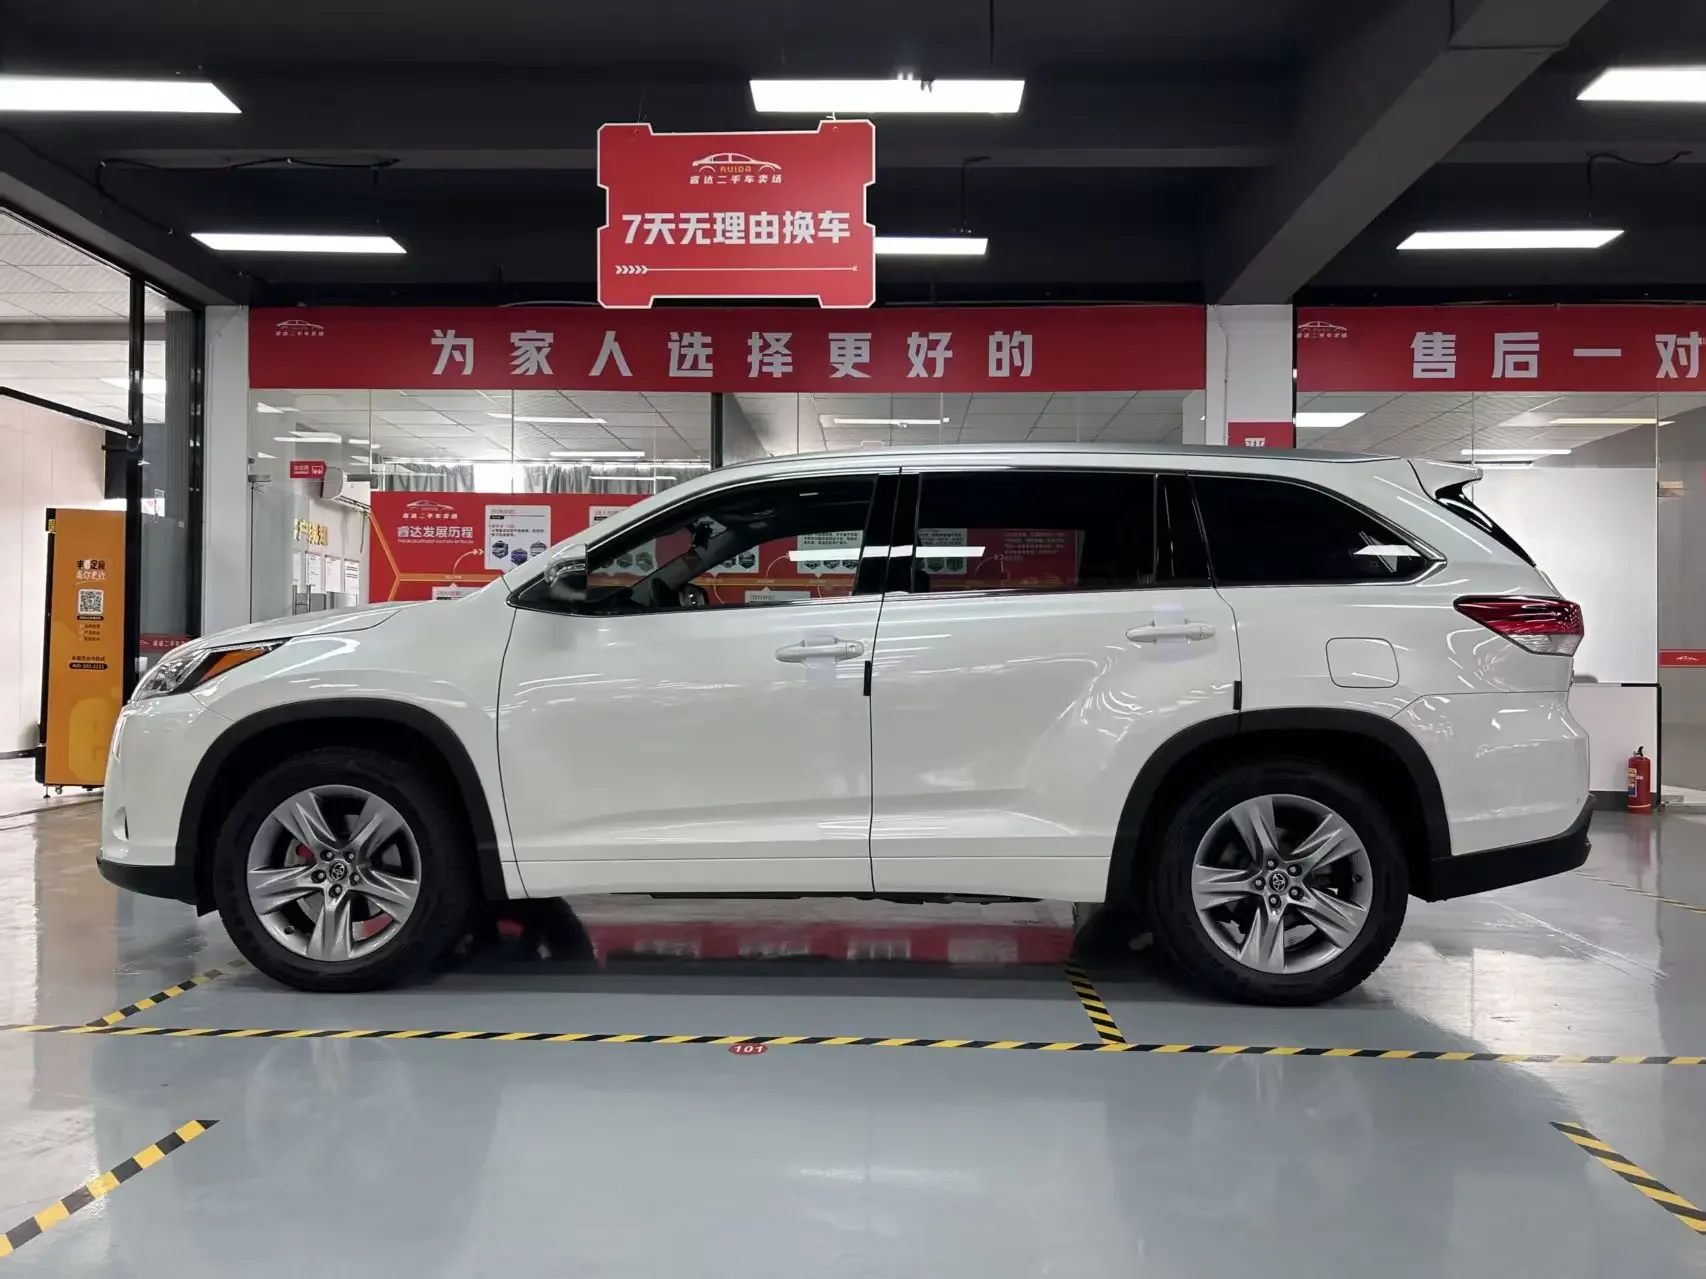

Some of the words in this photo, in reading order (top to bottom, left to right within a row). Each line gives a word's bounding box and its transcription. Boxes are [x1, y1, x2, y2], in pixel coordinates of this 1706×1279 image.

[689, 174, 783, 185] 睿达二手车卖场
[622, 210, 851, 245] 7天无理由换车
[431, 329, 1033, 378] 为家人选择更好的
[397, 526, 474, 539] 睿达发展历程
[734, 1045, 763, 1053] 101
